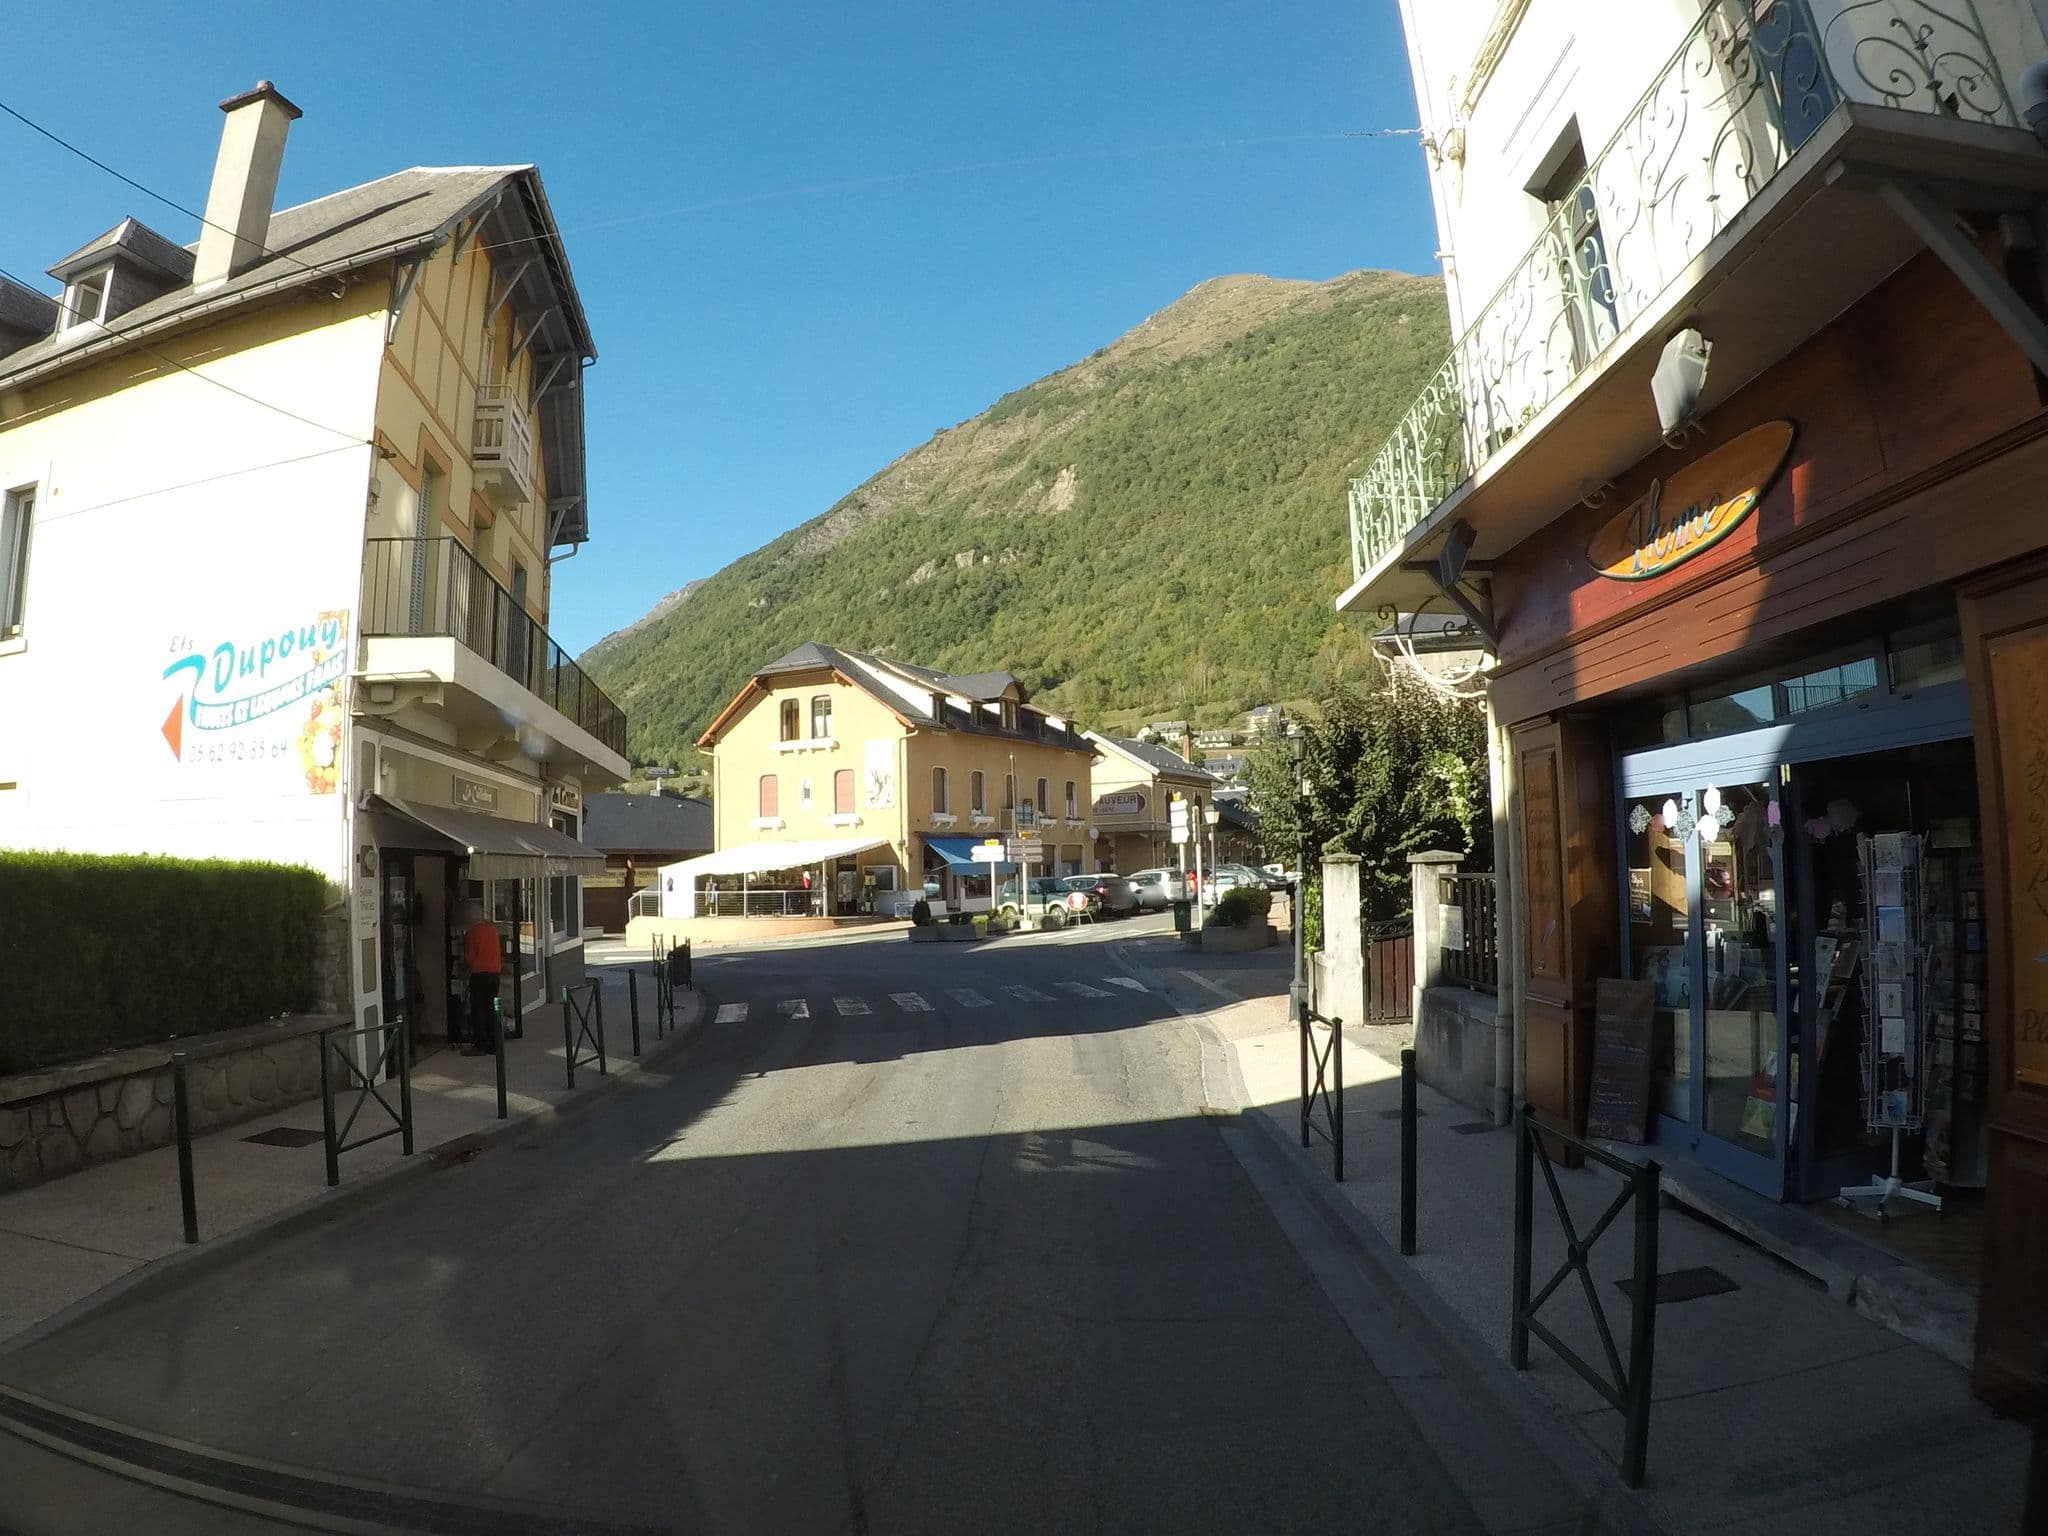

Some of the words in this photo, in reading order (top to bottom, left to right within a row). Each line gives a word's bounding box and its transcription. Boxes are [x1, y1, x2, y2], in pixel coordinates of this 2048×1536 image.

[170, 635, 194, 653] Ets
[213, 620, 338, 694] Dupouy
[208, 742, 224, 762] 62
[229, 741, 245, 760] 92
[1095, 795, 1137, 806] AUVEUR
